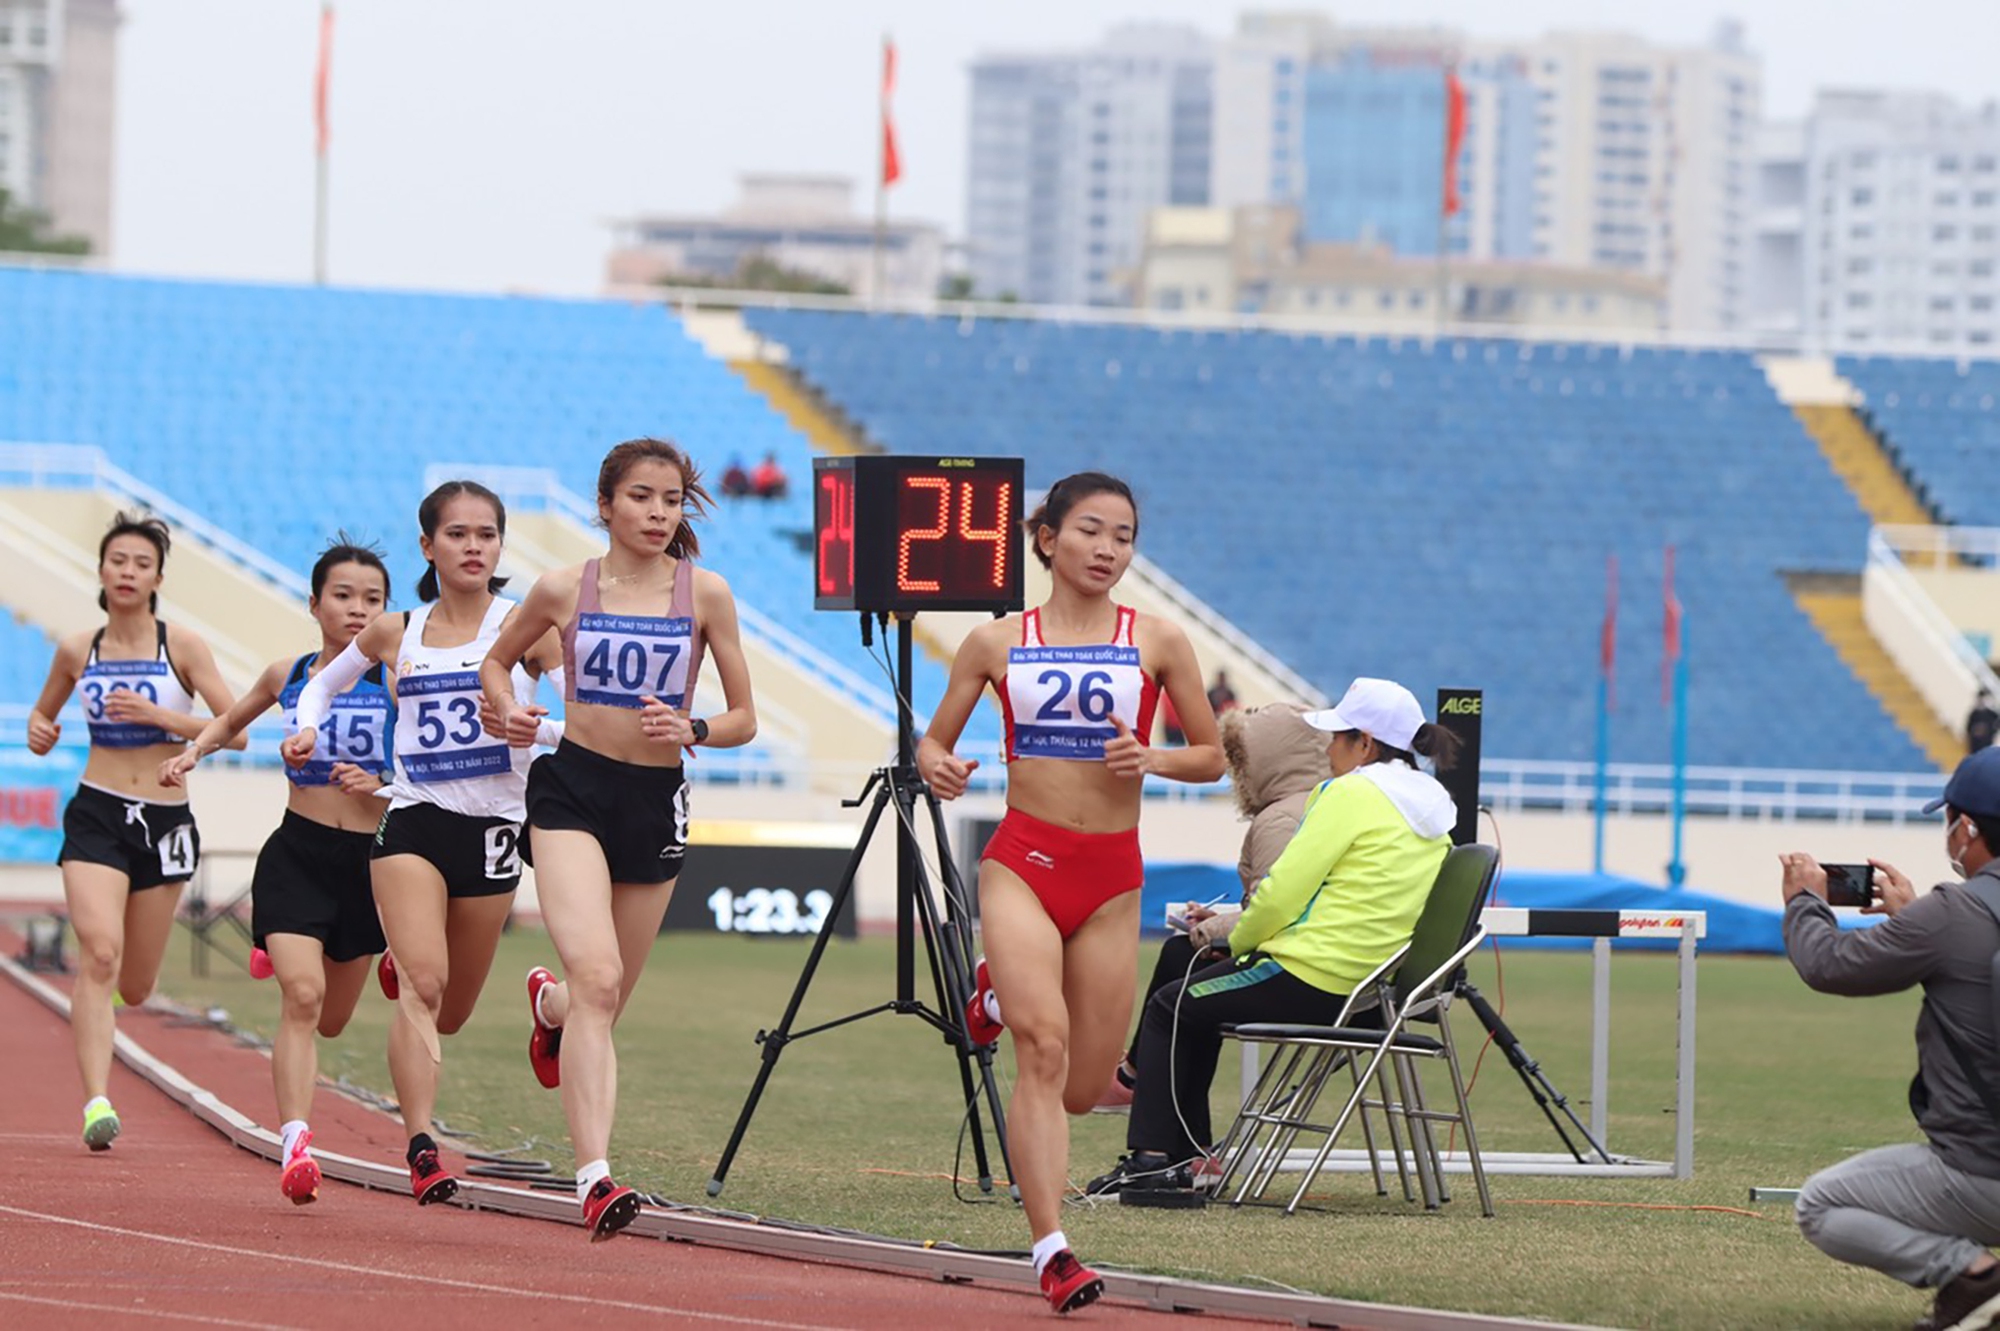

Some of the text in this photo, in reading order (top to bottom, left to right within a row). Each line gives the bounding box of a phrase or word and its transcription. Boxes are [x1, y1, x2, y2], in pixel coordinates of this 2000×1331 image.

[898, 476, 1010, 591] 24
[584, 638, 681, 691] 407
[1036, 669, 1114, 722] 26
[1440, 697, 1481, 714] ALGE
[417, 697, 481, 749] 53
[169, 829, 187, 868] 4
[494, 827, 516, 875] 2
